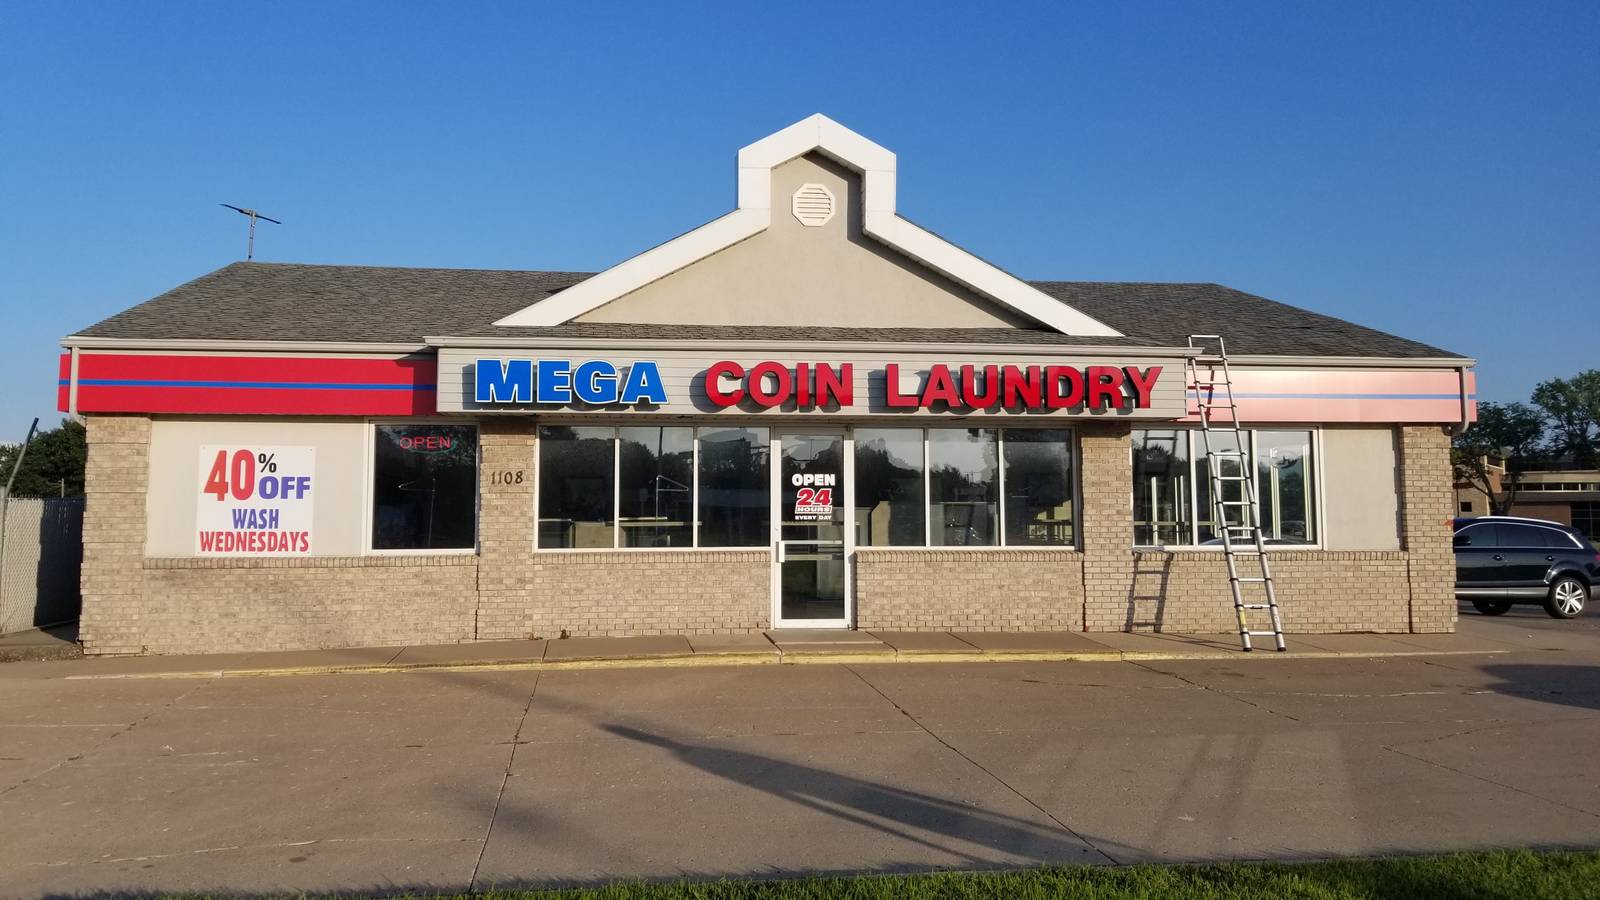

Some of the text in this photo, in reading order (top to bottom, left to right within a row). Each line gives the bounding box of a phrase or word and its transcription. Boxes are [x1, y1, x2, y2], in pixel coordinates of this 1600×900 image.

[475, 359, 1163, 409] MEGA COIN LAUNDRY
[400, 436, 451, 449] OPEN
[491, 471, 523, 485] 1108
[792, 473, 835, 486] OPEN
[258, 476, 311, 500] OFF
[797, 488, 832, 506] 24
[232, 509, 279, 529] WASH
[200, 531, 309, 552] WEDNESDAYS
